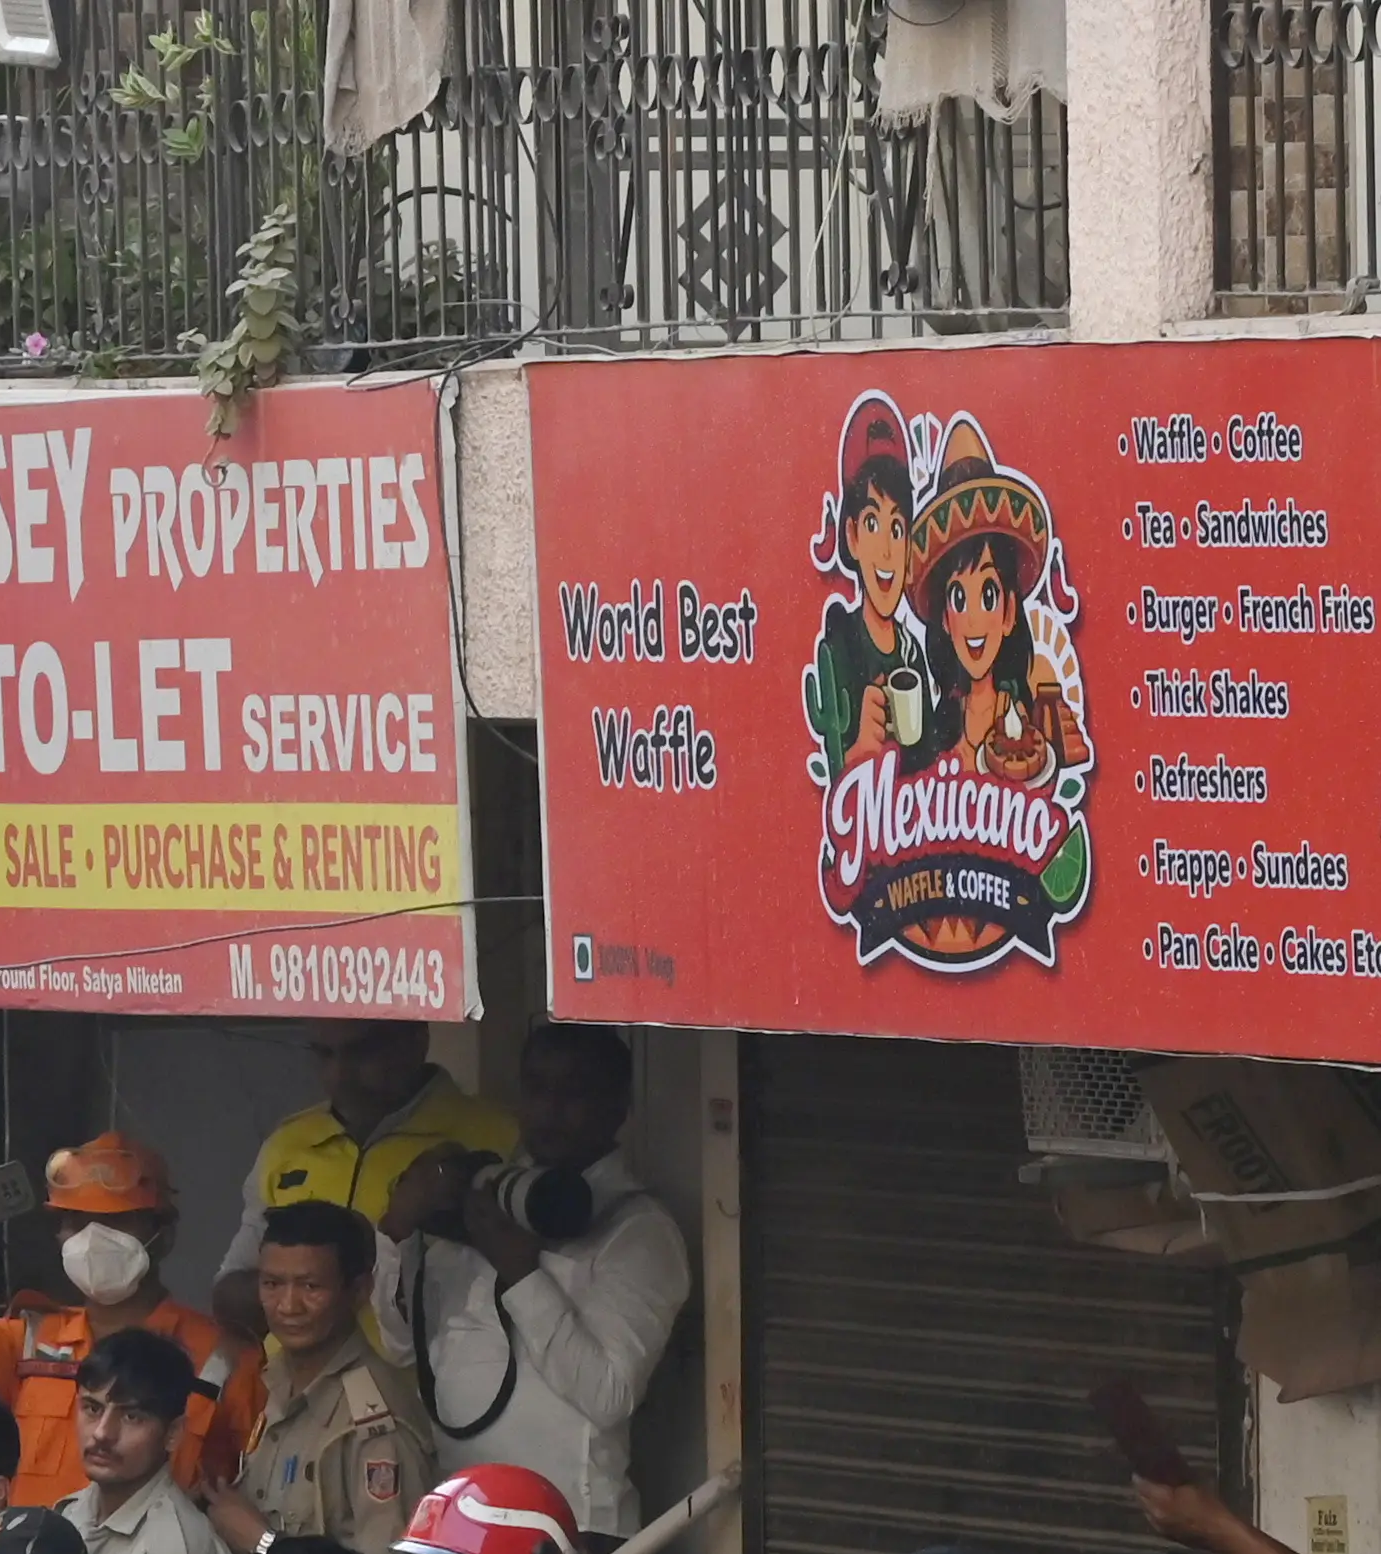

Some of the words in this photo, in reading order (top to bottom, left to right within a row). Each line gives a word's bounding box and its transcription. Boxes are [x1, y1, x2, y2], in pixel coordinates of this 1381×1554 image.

[1132, 414, 1206, 462] Waffle
[1227, 412, 1301, 462] Coffee
[110, 453, 429, 592] PROPERTIES
[1136, 502, 1175, 547] Tea
[1196, 498, 1328, 547] Sandwiches
[559, 579, 664, 665] World
[677, 579, 757, 665] Best
[1141, 586, 1217, 644] Burger
[1238, 583, 1314, 633] French
[1320, 584, 1376, 633] Fries
[1144, 669, 1207, 717] Thick
[1210, 669, 1289, 718] Shakes
[242, 693, 437, 773] SERVICE
[592, 704, 717, 792] Waffle
[1150, 752, 1267, 803] Refreshers
[832, 750, 1060, 886] Mexiicano
[5, 824, 76, 889] SALE
[104, 822, 265, 891] PURCHASE
[272, 824, 294, 882] &
[302, 823, 442, 896] RENTING
[1154, 839, 1231, 898] Frappe
[1252, 841, 1348, 890] Sundaes
[887, 869, 944, 911] WAFFLE
[945, 868, 955, 898] &
[957, 868, 1011, 910] COFFEE
[229, 943, 262, 1000] M.
[270, 943, 446, 1009] 9810392443
[1158, 922, 1200, 969] Pan
[1205, 922, 1259, 971] Cake
[1280, 925, 1346, 976] Cakes
[38, 965, 79, 996] Floor,
[82, 967, 124, 1000] Satya
[126, 969, 183, 995] Niketan
